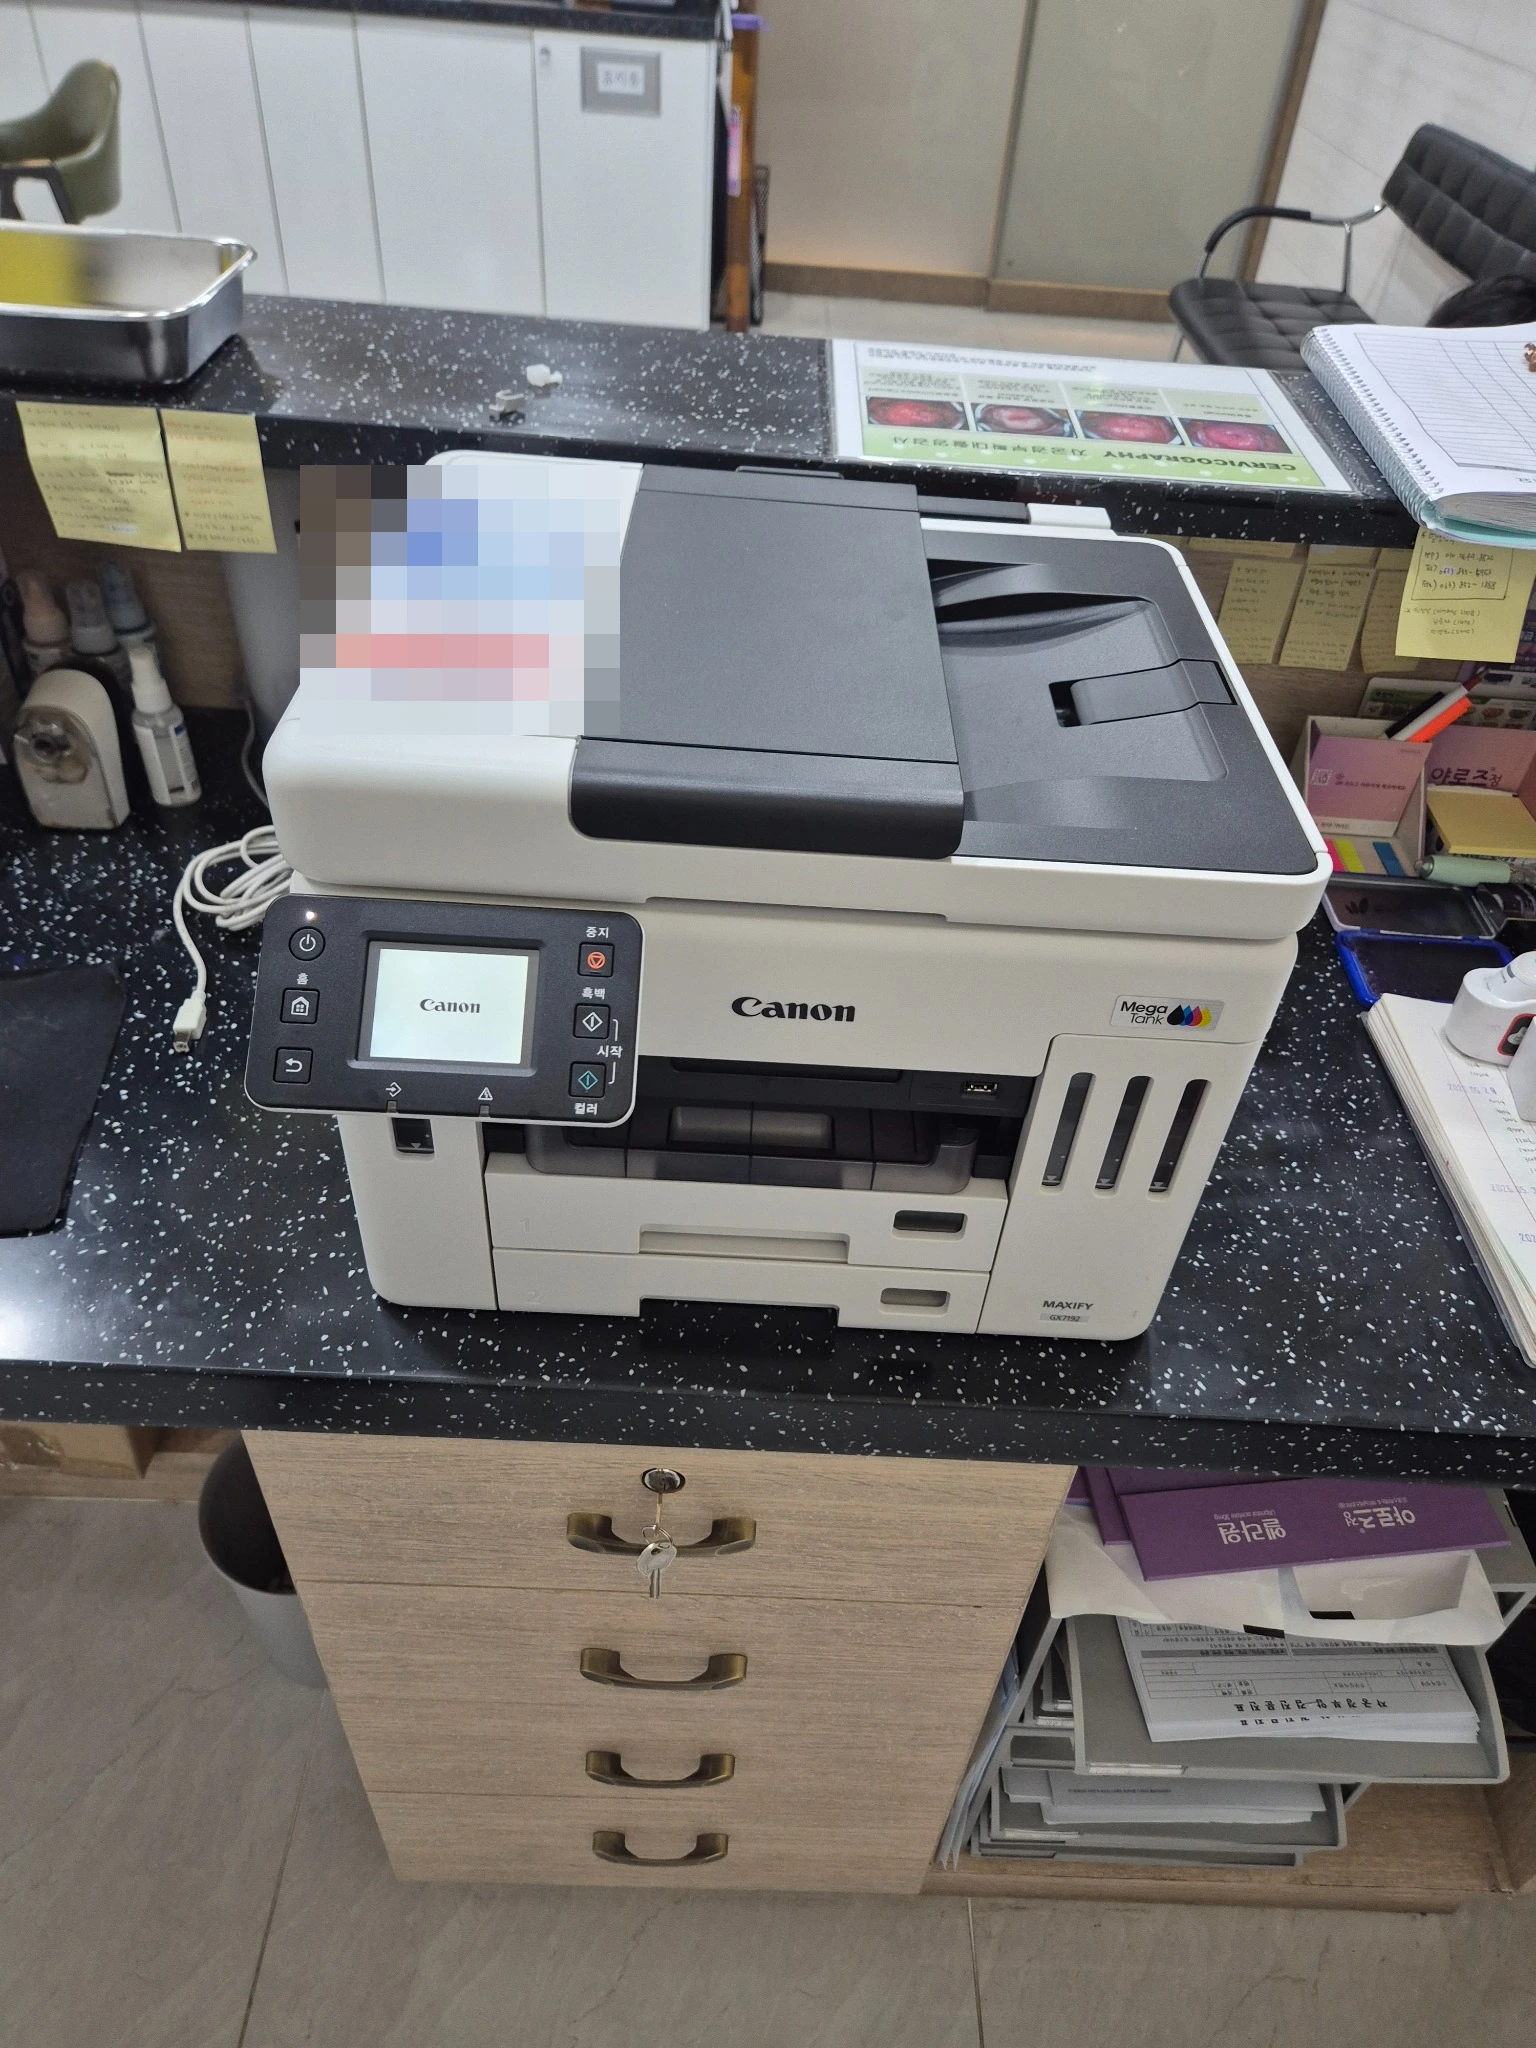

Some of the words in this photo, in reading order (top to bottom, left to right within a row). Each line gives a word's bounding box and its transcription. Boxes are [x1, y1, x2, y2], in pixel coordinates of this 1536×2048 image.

[1102, 450, 1297, 472] CERVICOGRAPHY
[586, 925, 610, 940] 중지
[296, 972, 309, 985] 홈
[581, 986, 606, 1000] 흑백
[419, 998, 481, 1014] Canon
[731, 996, 856, 1022] Canon
[1120, 1000, 1169, 1016] Mega
[1130, 1012, 1165, 1025] Tank
[597, 1044, 624, 1058] 시작
[574, 1101, 598, 1116] 컬러
[1042, 1300, 1094, 1311] MAXIFY
[1049, 1314, 1081, 1322] GX7192
[1216, 1518, 1287, 1545] 엘라원
[1232, 1699, 1307, 1714] 검진문진표
[1315, 1698, 1388, 1710] 자궁경부암
